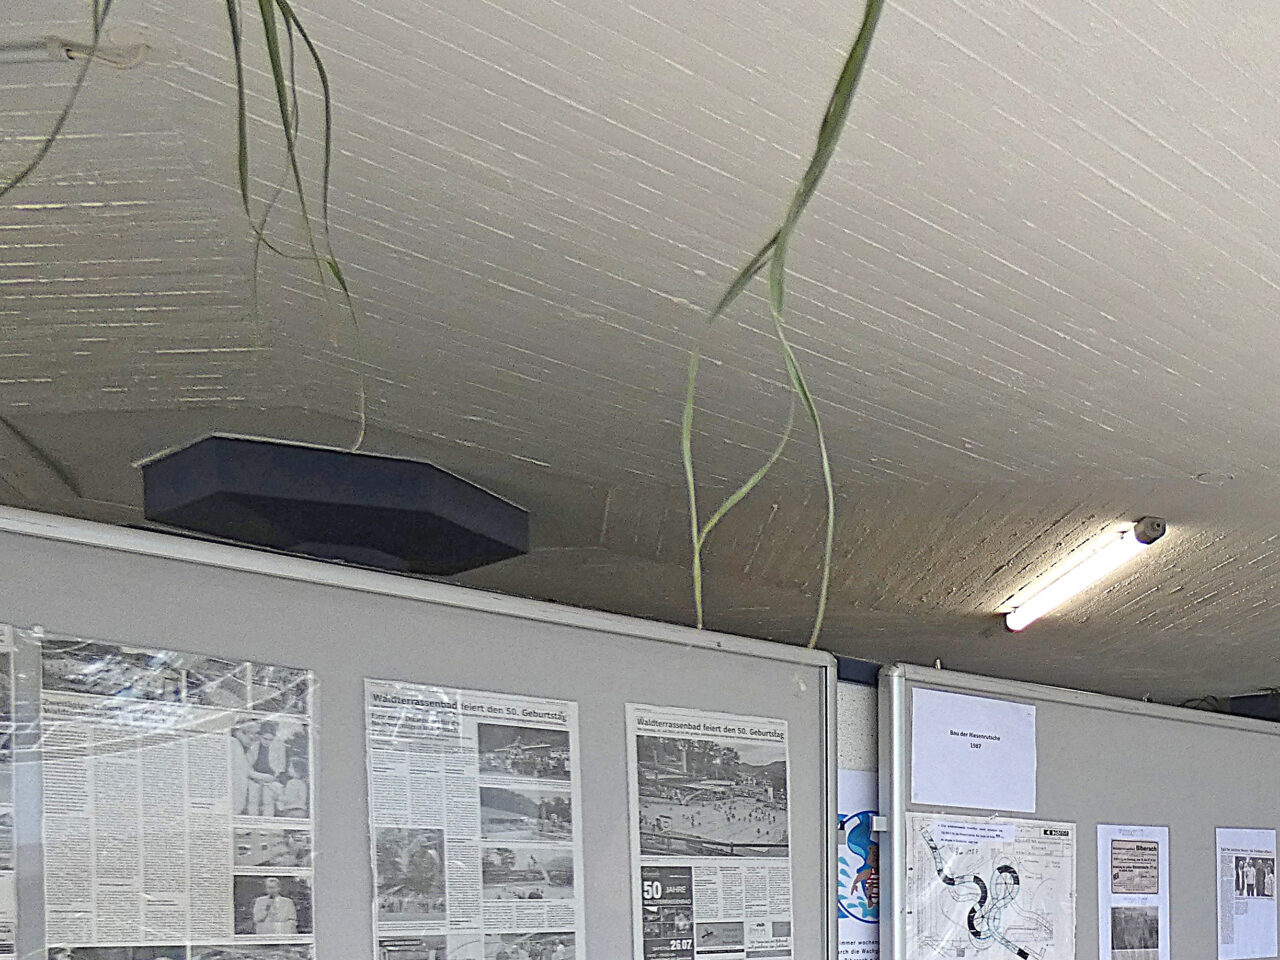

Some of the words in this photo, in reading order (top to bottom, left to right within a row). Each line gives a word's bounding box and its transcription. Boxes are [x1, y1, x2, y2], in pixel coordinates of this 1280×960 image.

[373, 694, 457, 710] Waldterrassenbad
[487, 705, 504, 715] den
[506, 707, 520, 717] 50.
[522, 709, 567, 723] Geburtstag
[637, 717, 701, 730] Waldterrassenbad
[702, 723, 721, 734] feiert
[723, 725, 736, 735] den
[737, 727, 748, 736] 50.
[749, 728, 784, 740] Geburtstag
[643, 881, 662, 899] 50
